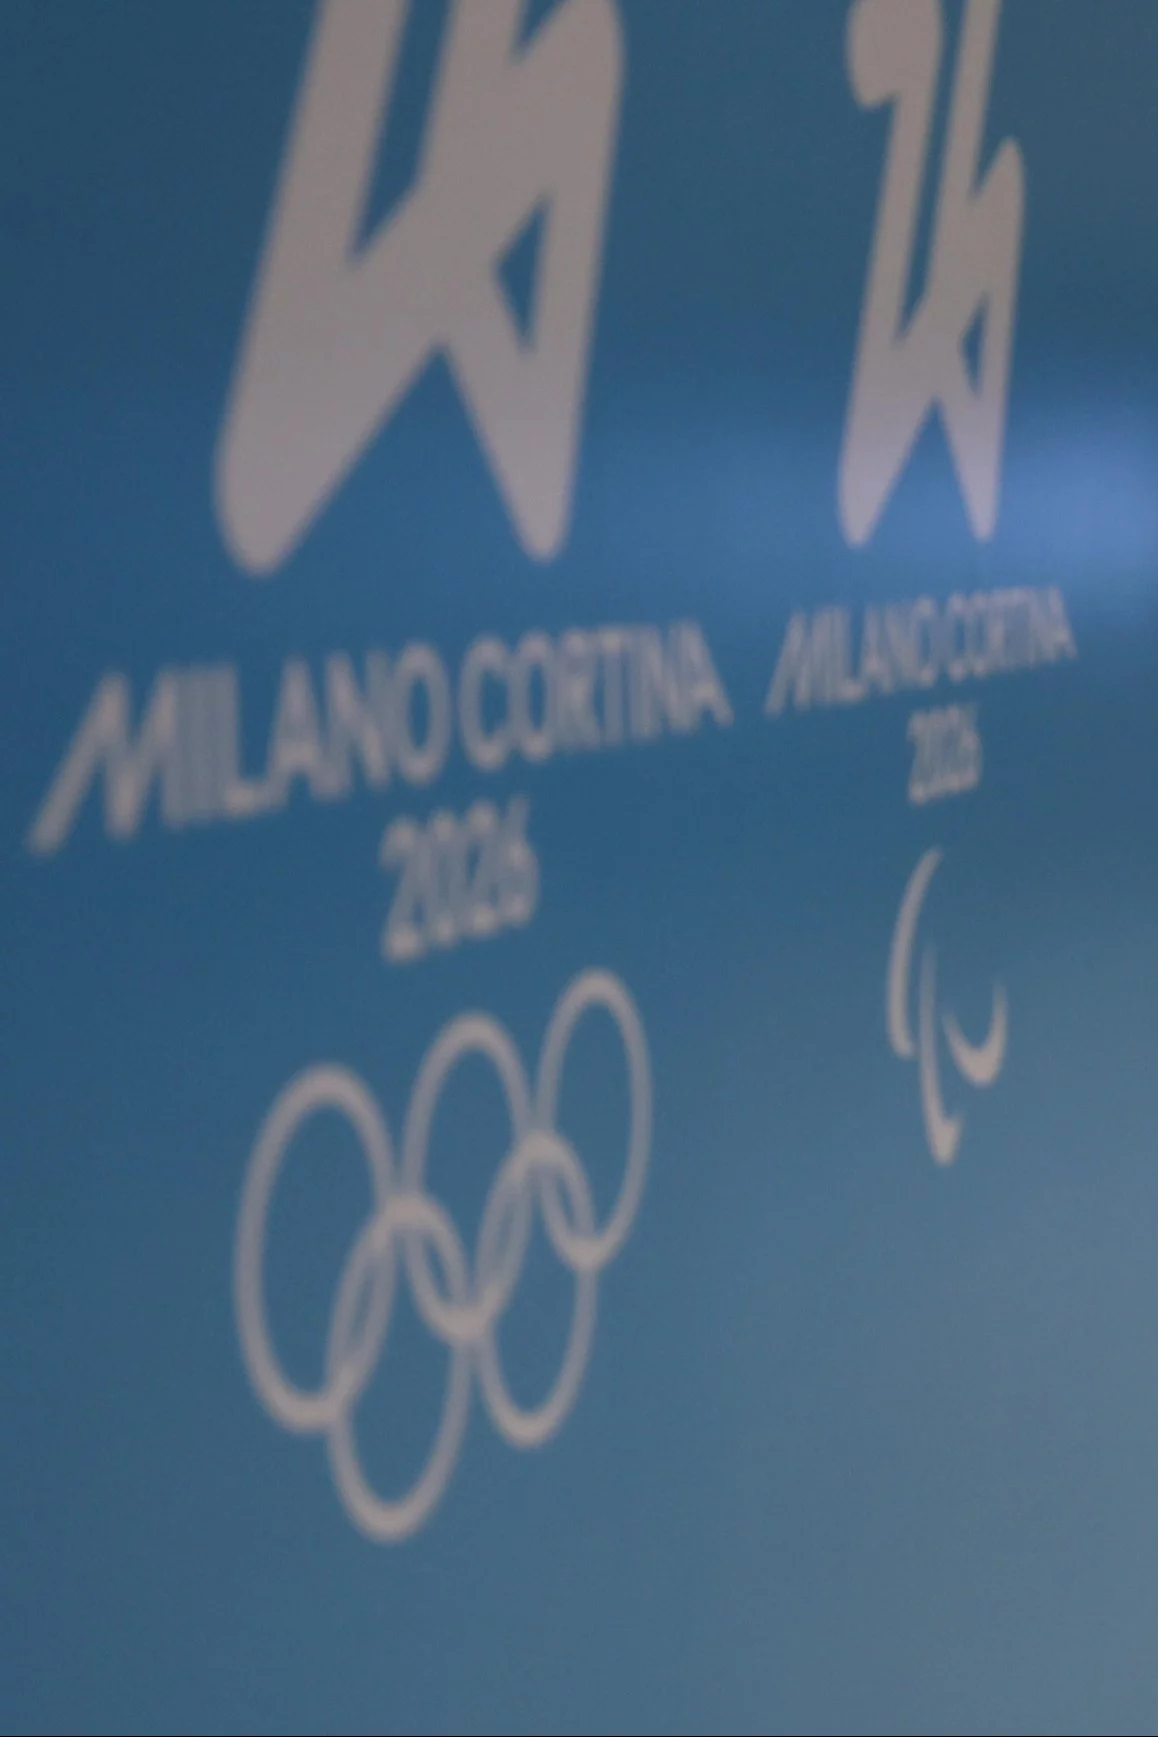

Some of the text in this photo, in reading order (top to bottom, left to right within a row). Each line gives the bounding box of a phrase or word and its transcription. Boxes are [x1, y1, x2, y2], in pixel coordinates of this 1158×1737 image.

[24, 618, 735, 857] MILANO CORTINA
[762, 584, 1077, 722] MILANO CORTINA
[378, 793, 542, 963] 2026
